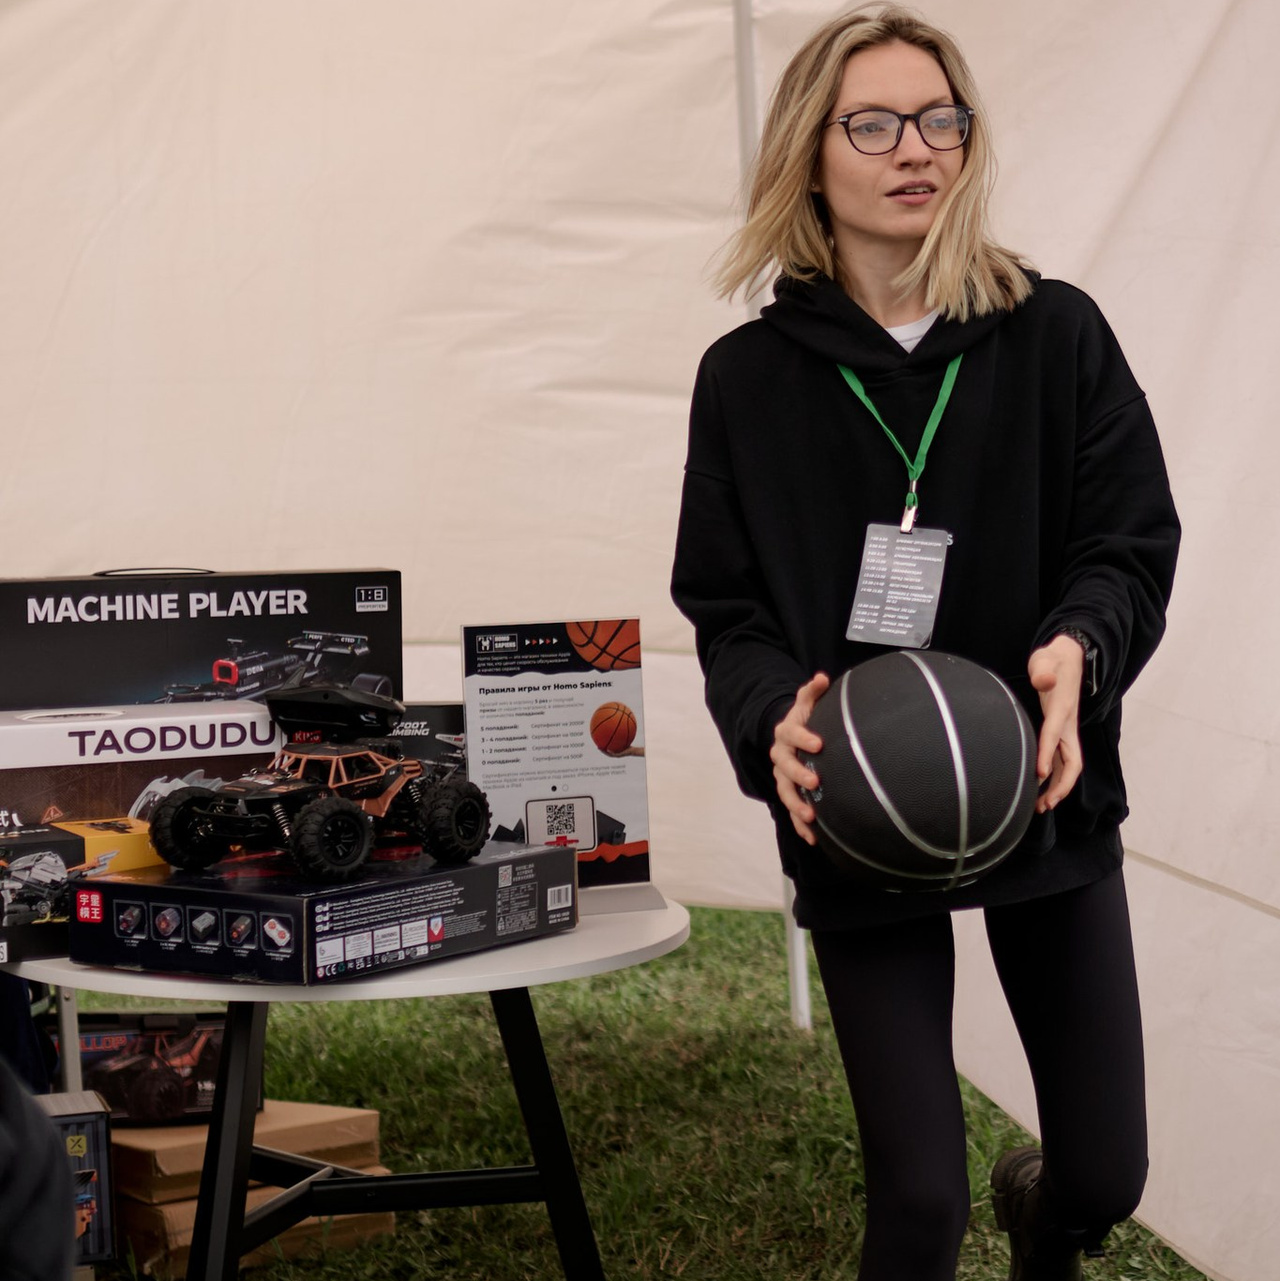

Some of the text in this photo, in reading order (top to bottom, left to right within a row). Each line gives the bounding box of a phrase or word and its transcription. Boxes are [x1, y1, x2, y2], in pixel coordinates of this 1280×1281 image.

[27, 588, 309, 624] MACHINE PLAYER
[360, 589, 384, 601] 1:8
[478, 686, 515, 695] Правила
[553, 682, 577, 690] Homo
[69, 719, 276, 757] TAODUDU
